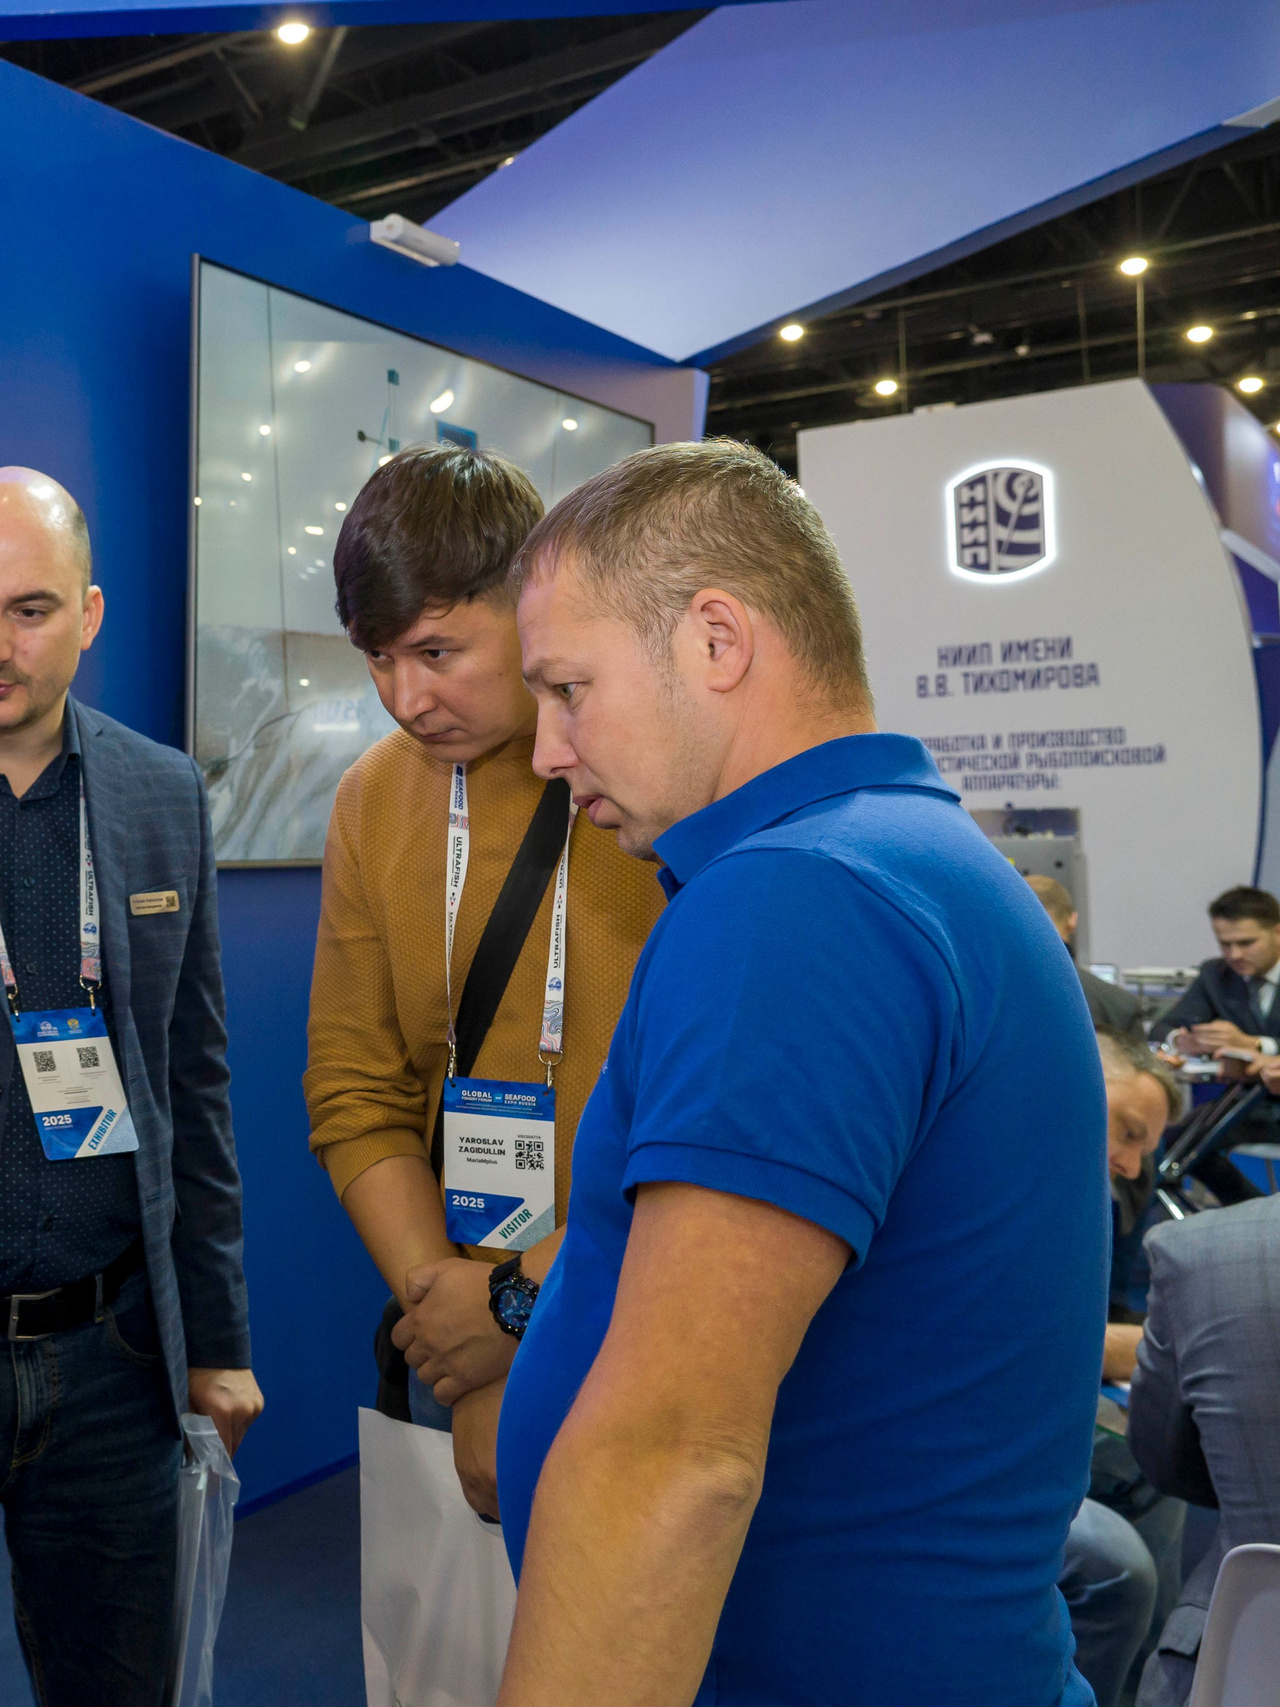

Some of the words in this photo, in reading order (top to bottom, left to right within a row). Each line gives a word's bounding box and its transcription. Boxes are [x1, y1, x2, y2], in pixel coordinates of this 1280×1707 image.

[937, 641, 992, 668] НИИП
[1000, 636, 1073, 662] ИМЕНИ
[916, 674, 954, 699] В.В.
[962, 662, 1100, 695] ТИХОМИРОВА
[1007, 726, 1126, 750] ПРОИЗВОДСТВО
[1025, 742, 1167, 770] РЫБОПОИСКОВОЙ
[453, 836, 463, 888] ULTRAFISH
[553, 914, 561, 969] ULTRAFISH
[461, 1090, 492, 1098] GLOBAL
[504, 1094, 536, 1102] SEAFOOD
[42, 1114, 73, 1127] 2025
[88, 1108, 117, 1151] EXHIBITOR
[458, 1146, 506, 1156] ZAGIDULLIN
[459, 1136, 504, 1146] YAROSLAV
[452, 1194, 485, 1209] 2025
[498, 1208, 533, 1240] VISITOR
